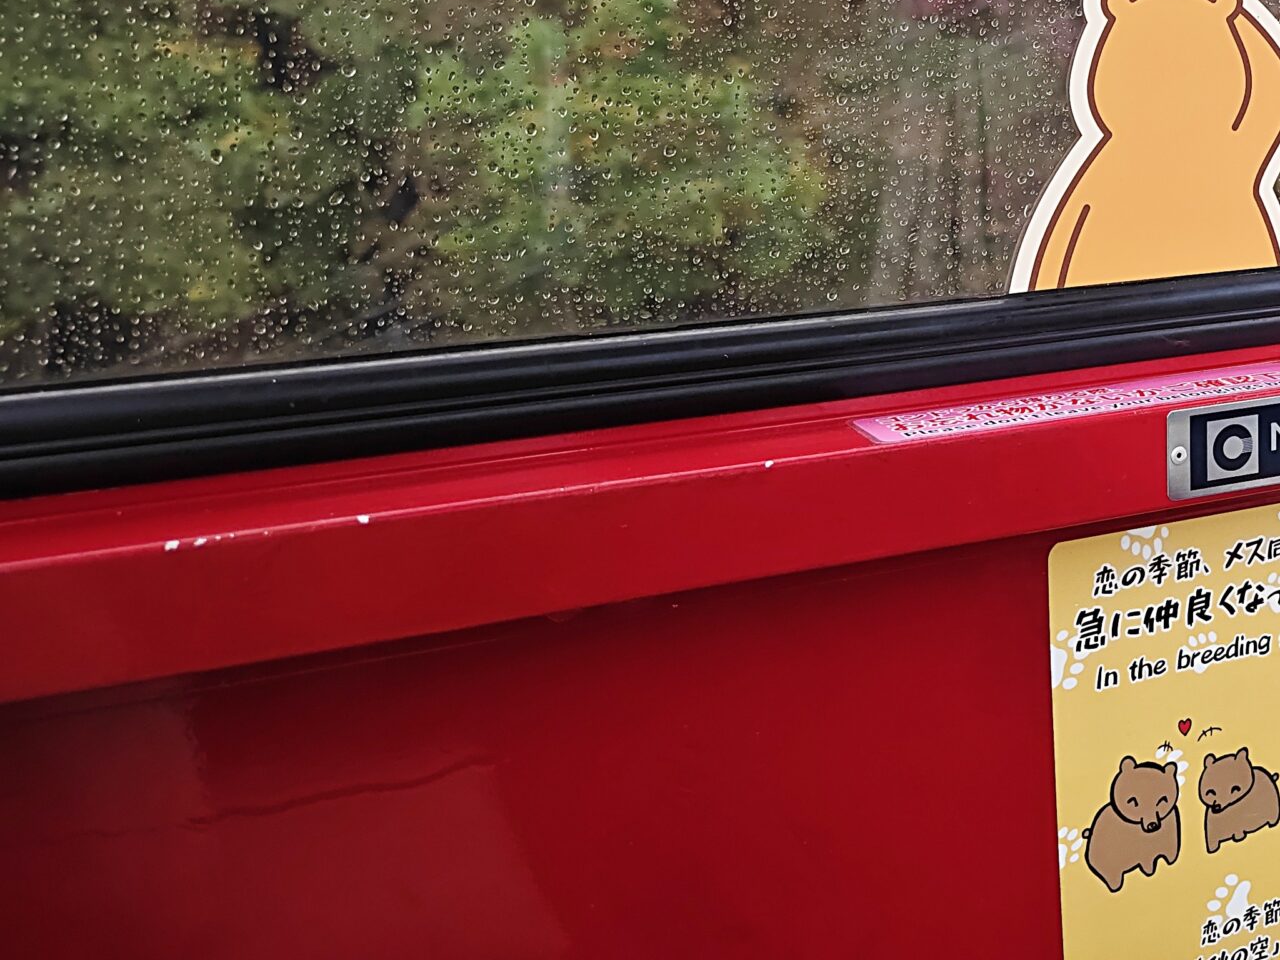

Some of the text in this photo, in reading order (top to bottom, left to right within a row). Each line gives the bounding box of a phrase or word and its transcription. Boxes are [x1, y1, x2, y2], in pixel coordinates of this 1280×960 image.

[904, 423, 977, 437] Please
[1049, 405, 1101, 418] leave
[1111, 397, 1153, 409] your
[1096, 666, 1118, 690] In
[1130, 657, 1166, 681] the
[1177, 633, 1271, 670] breeding
